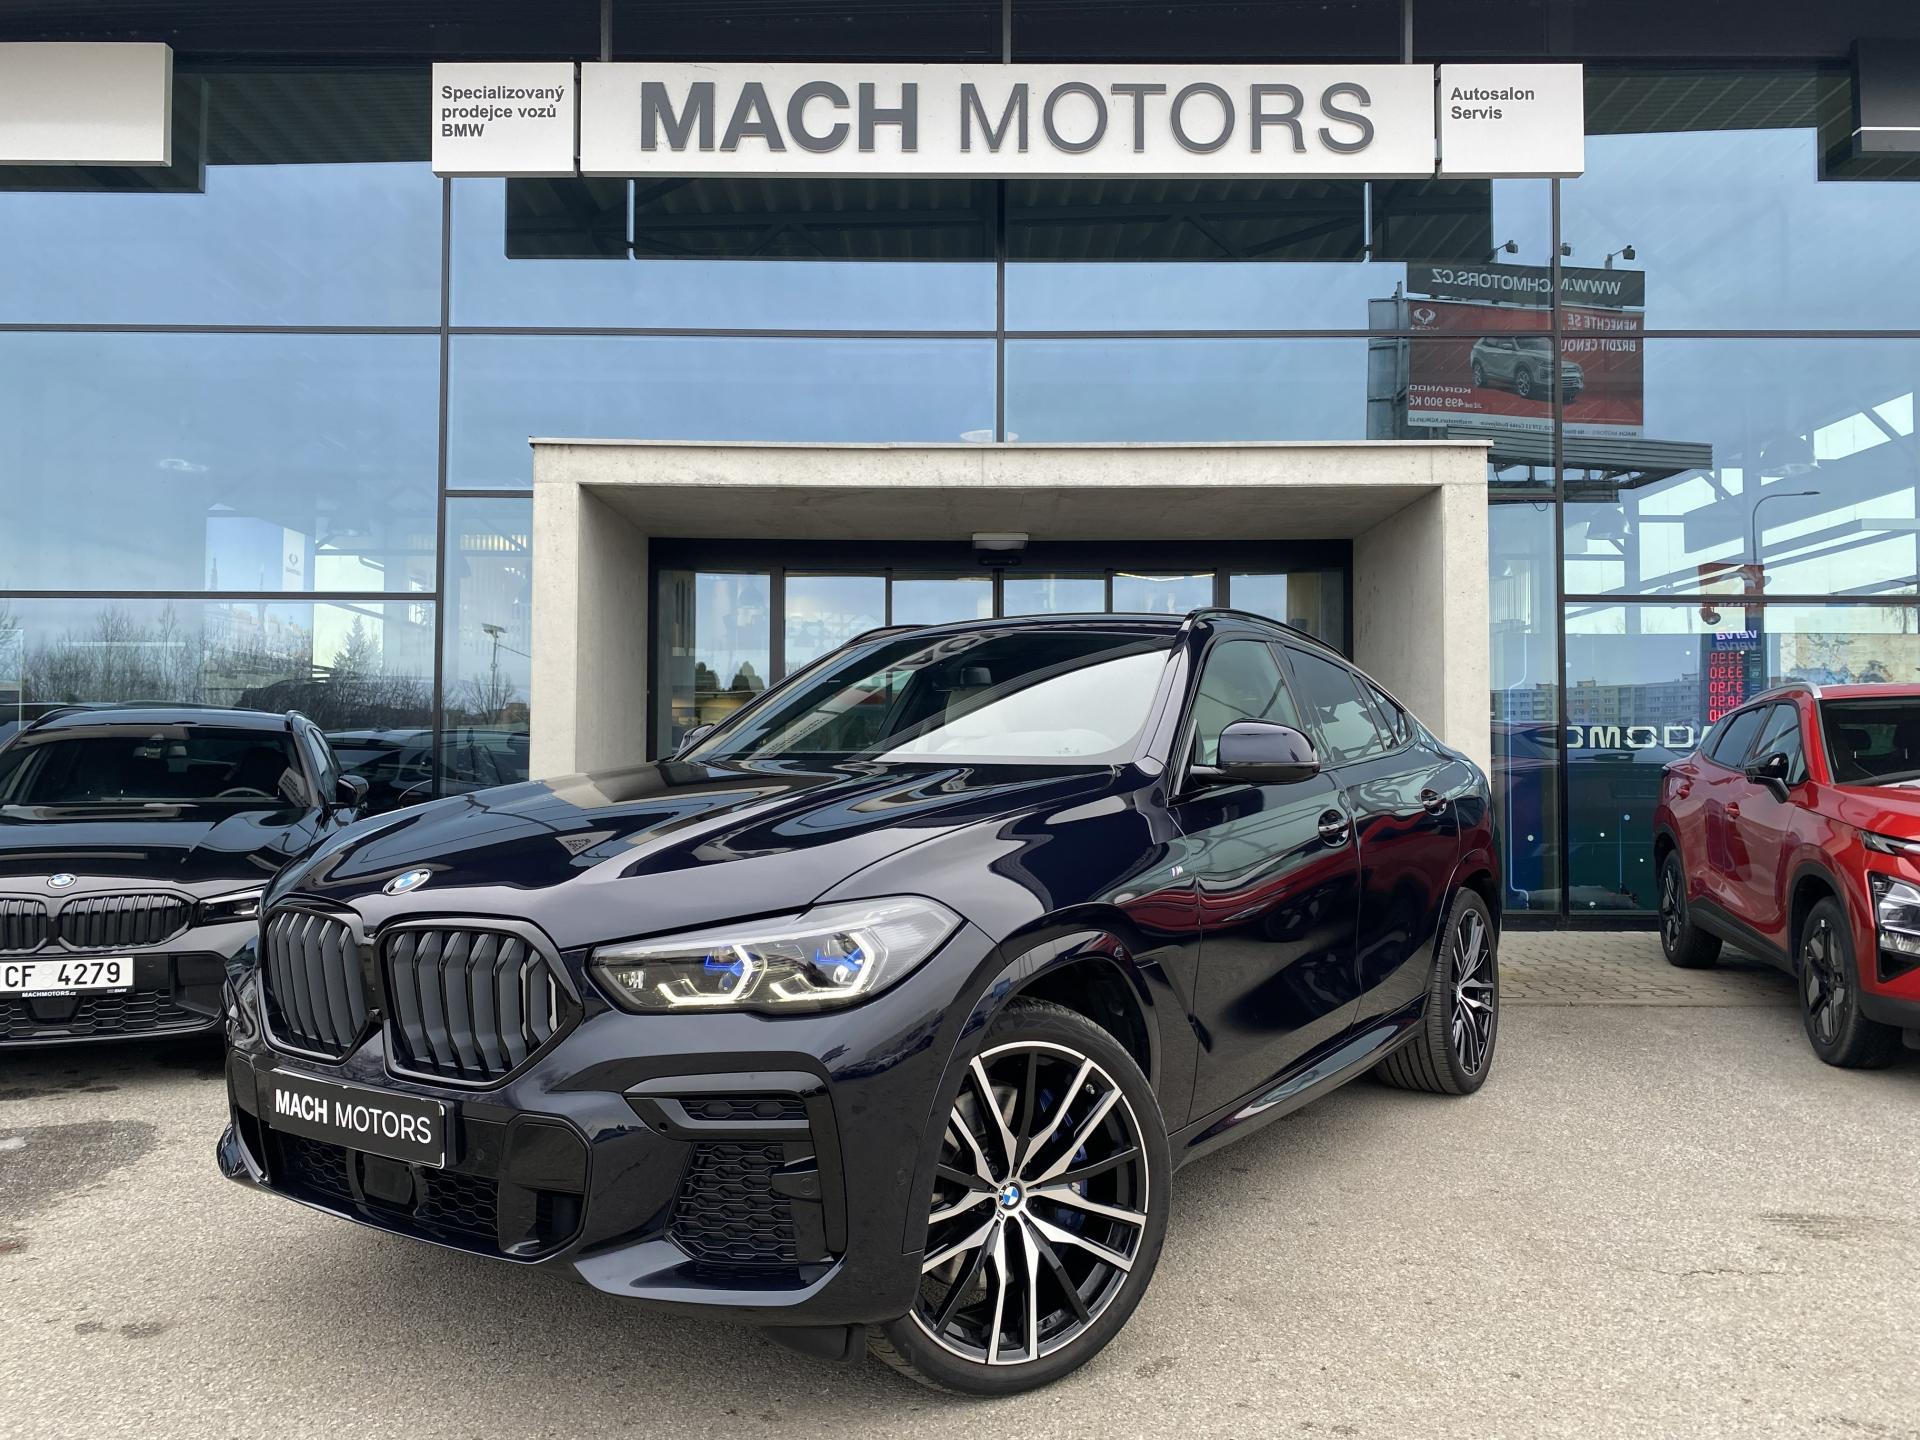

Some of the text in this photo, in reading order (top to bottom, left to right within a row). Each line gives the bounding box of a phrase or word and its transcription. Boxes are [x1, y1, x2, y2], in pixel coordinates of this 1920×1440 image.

[441, 85, 565, 102] Specializovaný
[1450, 87, 1535, 101] Autosalon
[441, 103, 557, 121] prodejce vozů
[640, 80, 1375, 154] MACH MOTORS
[1450, 105, 1503, 120] Servis
[441, 123, 485, 137] BMW
[1566, 726, 1713, 748] OMOD
[5, 962, 121, 988] CF 4279
[275, 1088, 432, 1144] MACH MOTORS
